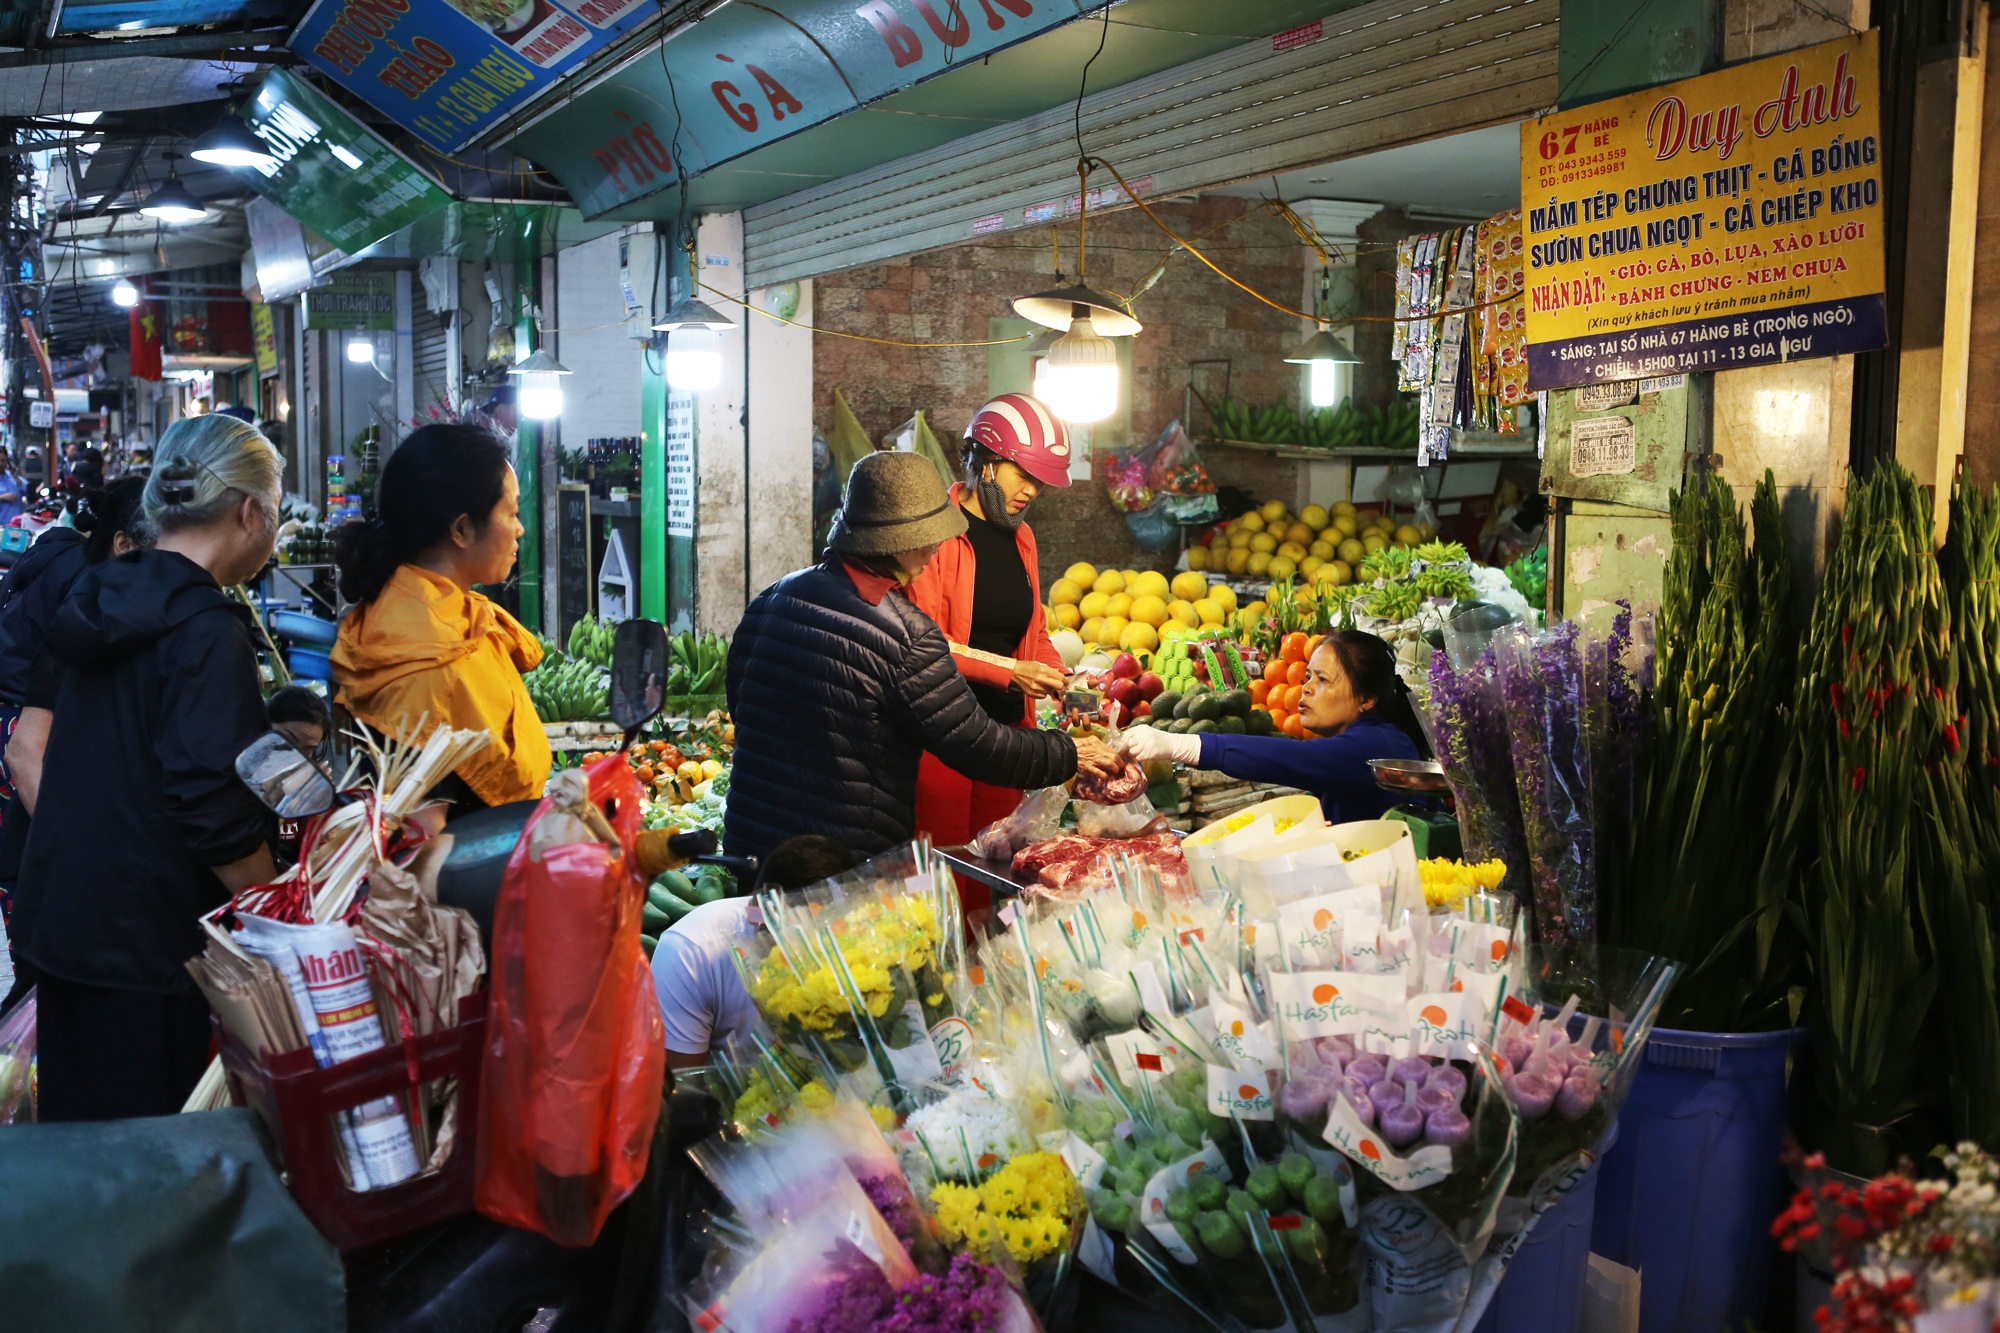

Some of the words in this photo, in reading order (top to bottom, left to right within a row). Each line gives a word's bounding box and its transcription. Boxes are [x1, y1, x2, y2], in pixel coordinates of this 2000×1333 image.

[448, 76, 504, 113] GIA
[711, 53, 804, 133] GÀ
[1645, 95, 1745, 162] Duy
[1751, 50, 1861, 138] Anh
[1539, 123, 1583, 161] 67
[1584, 116, 1620, 135] HÀNG
[1593, 132, 1611, 148] BÈ
[1539, 164, 1556, 177] ĐT:
[1558, 159, 1577, 172] 043
[1579, 153, 1606, 167] 9343
[1607, 147, 1627, 160] 559
[1561, 161, 1626, 184] 0913349981
[1529, 195, 1580, 235] MẮM
[1581, 188, 1621, 224] TÉP
[1623, 173, 1699, 216] CHƯNG
[1702, 163, 1753, 200] THỊT
[1772, 147, 1807, 185] CÁ
[1811, 133, 1878, 178] BỐNG
[1530, 233, 1585, 269] SƯỜN
[1587, 224, 1643, 259] CHUA
[1646, 211, 1706, 249] NGỌT
[1724, 197, 1757, 235] CÁ
[1760, 185, 1825, 228] CHÉP
[1829, 177, 1880, 215] KHO
[1655, 252, 1687, 274] GÀ,
[1689, 246, 1721, 269] BÒ,
[1724, 242, 1769, 266] LỤA,
[1772, 232, 1815, 254] XÀO
[1817, 221, 1866, 246] LƯỠI
[1531, 274, 1571, 317] NHẬN
[1572, 269, 1608, 312] ĐẶT:
[1668, 273, 1734, 298] CHƯNG
[1746, 264, 1788, 287] NEM
[1791, 255, 1848, 280] CHUA
[1587, 315, 1609, 331] (Xin
[1611, 310, 1633, 327] quý
[1634, 304, 1670, 321] khách
[1693, 300, 1702, 315] ý
[1703, 296, 1737, 312] tránh
[1738, 293, 1767, 306] mua
[1560, 343, 1597, 361] SÁNG:
[1599, 340, 1618, 357] TẠI
[1620, 331, 1638, 352] SỐ
[1640, 328, 1668, 350] NHÀ
[1670, 330, 1686, 346] 67
[1689, 323, 1730, 343] HÀNG
[1733, 318, 1749, 337] BÈ
[1637, 354, 1676, 374] 15H00
[1678, 351, 1699, 370] TẠI
[1702, 349, 1717, 364] 11
[1730, 346, 1746, 361] 13
[1749, 342, 1776, 359] GIA
[938, 1029, 964, 1067] 25
